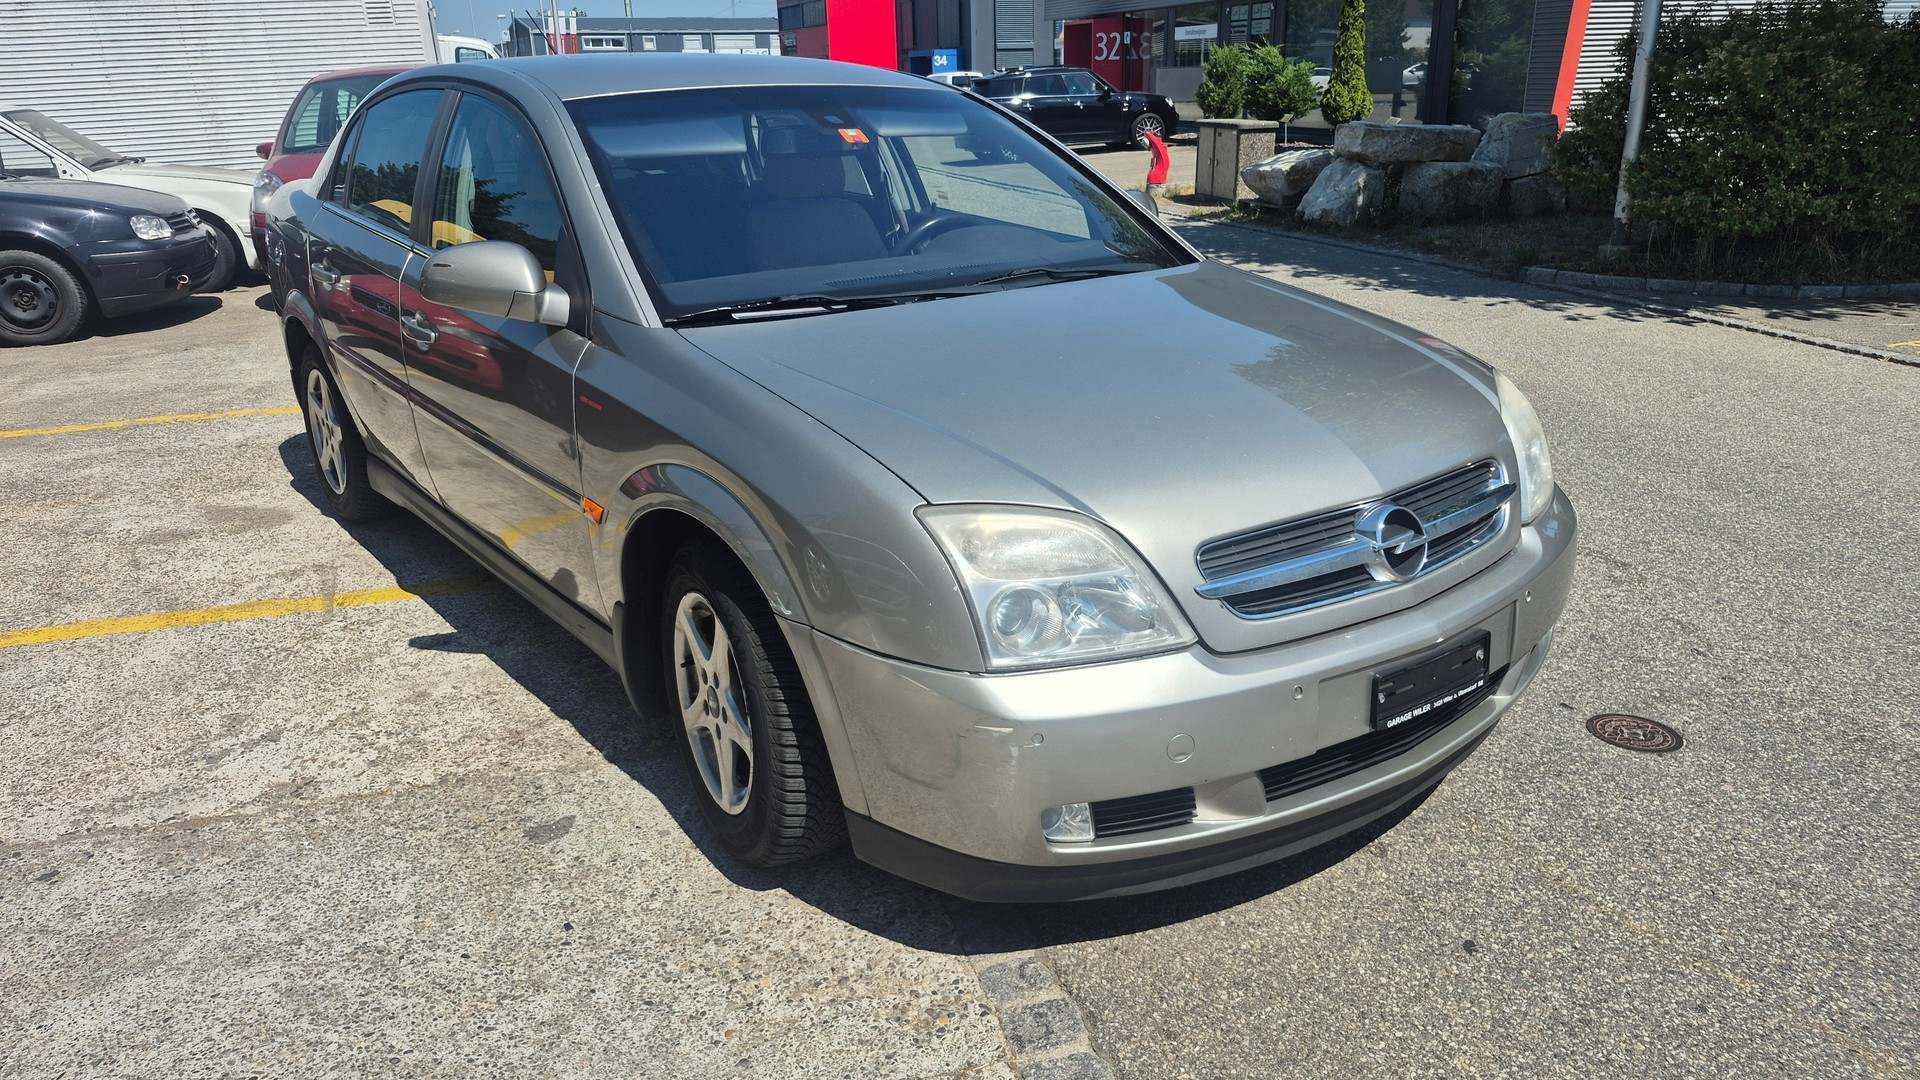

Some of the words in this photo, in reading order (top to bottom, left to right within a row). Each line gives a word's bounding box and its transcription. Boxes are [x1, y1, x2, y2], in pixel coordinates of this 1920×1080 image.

[1094, 31, 1121, 61] 32
[934, 54, 948, 67] 34
[1386, 711, 1413, 728] GARAGE
[1412, 703, 1431, 717] WILER
